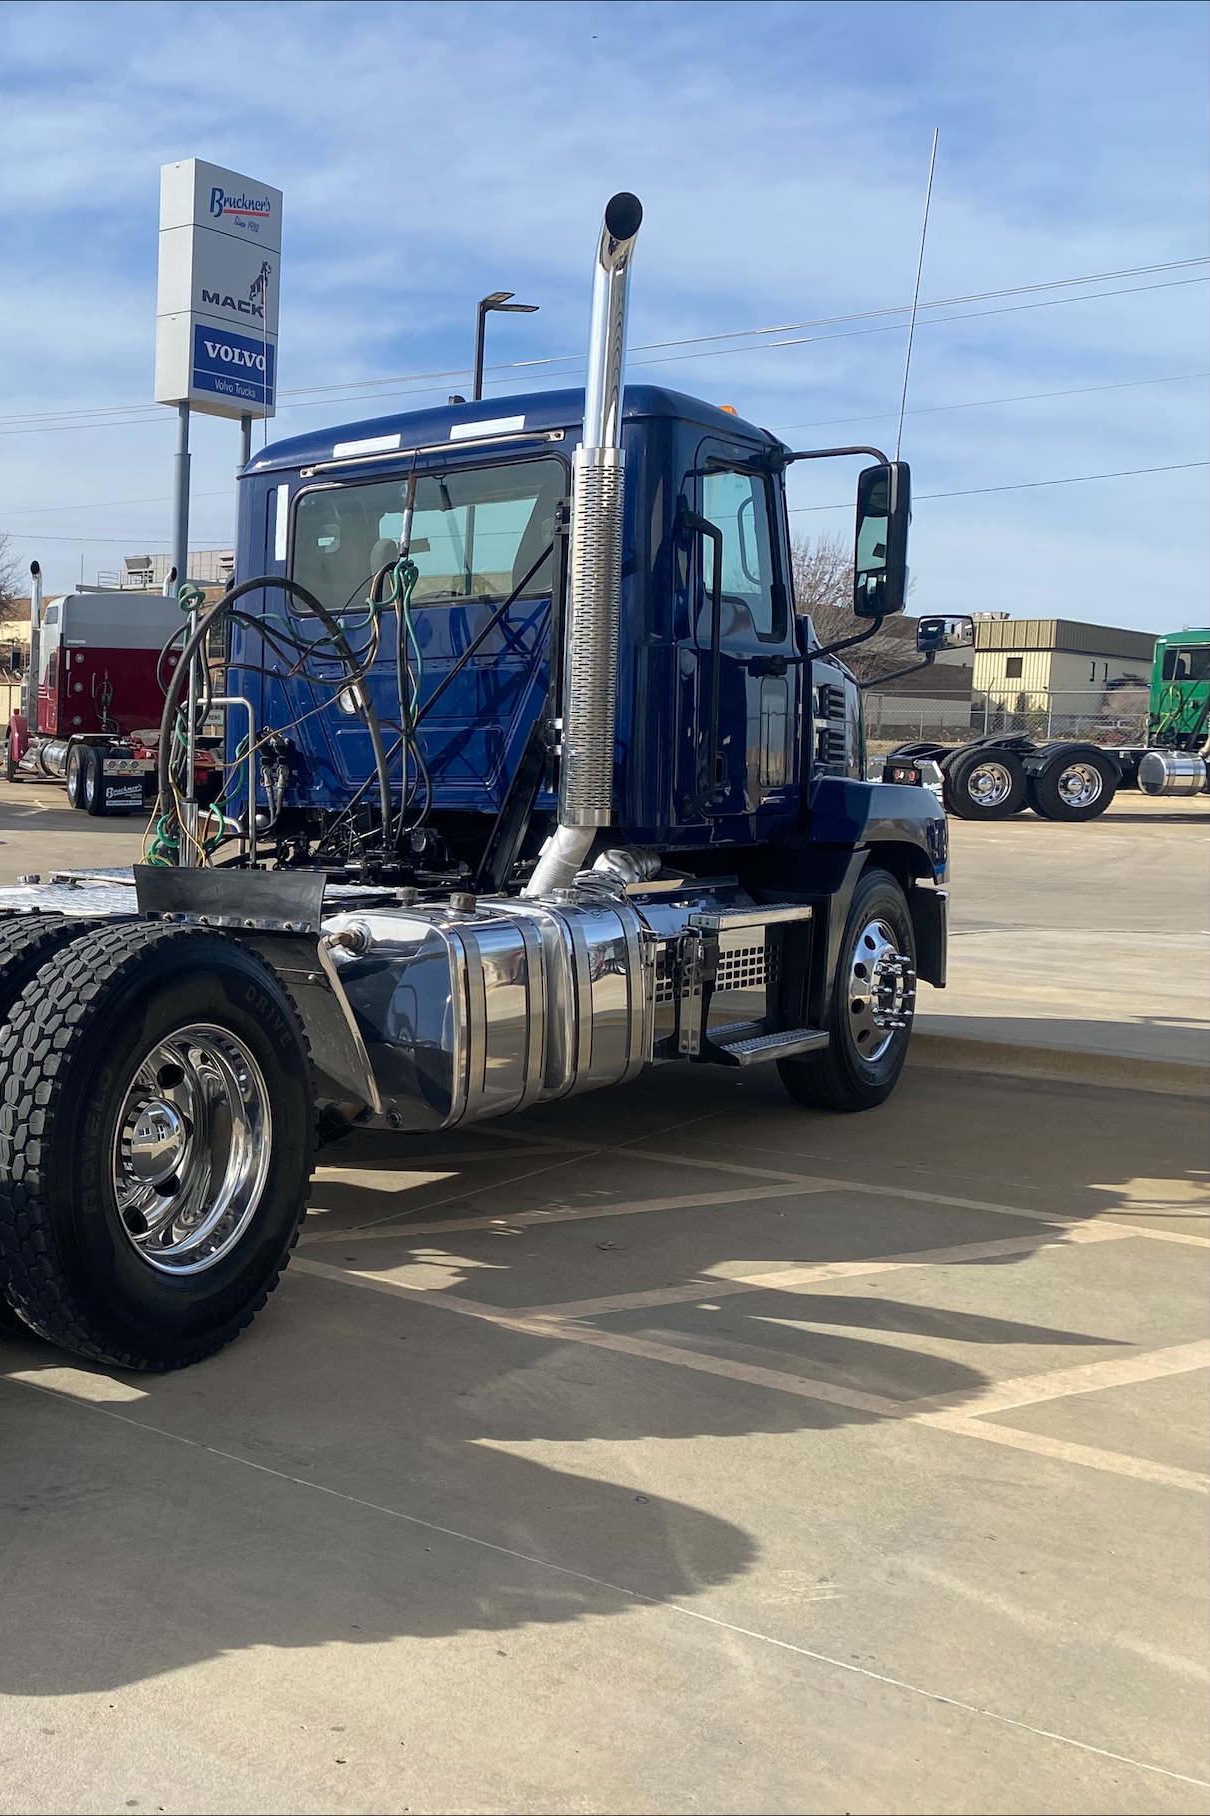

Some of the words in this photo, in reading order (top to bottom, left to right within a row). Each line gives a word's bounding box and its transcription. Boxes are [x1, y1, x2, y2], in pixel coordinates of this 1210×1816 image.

[209, 187, 270, 218] Bruckner's
[202, 289, 264, 319] MACK
[204, 340, 266, 371] VOLVO
[214, 378, 234, 394] Volvo
[234, 382, 256, 399] Trucks
